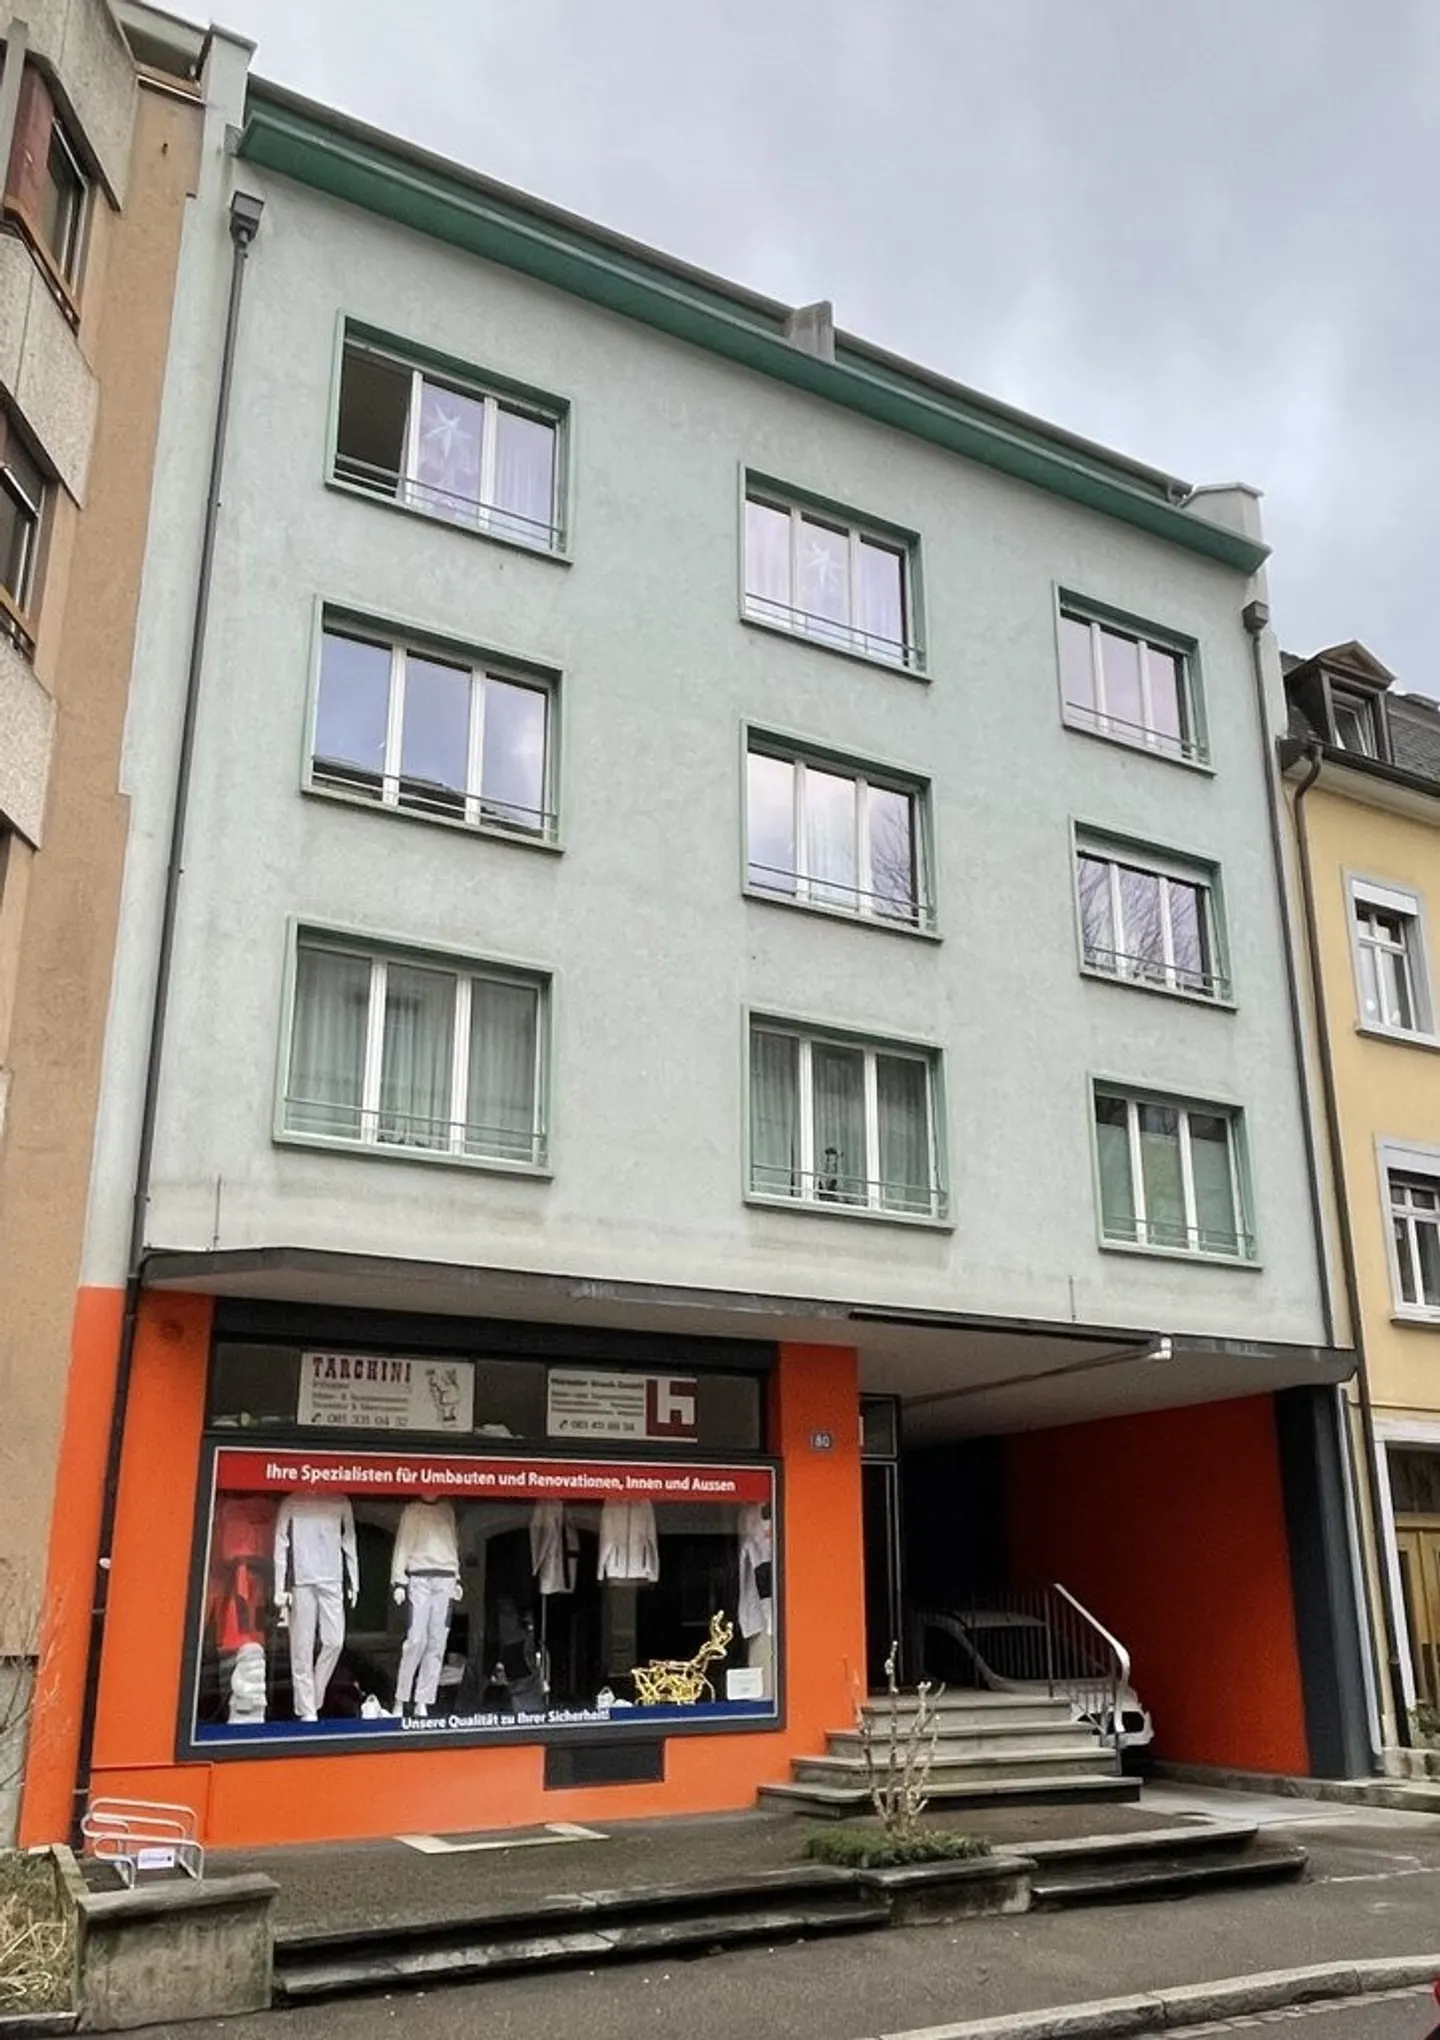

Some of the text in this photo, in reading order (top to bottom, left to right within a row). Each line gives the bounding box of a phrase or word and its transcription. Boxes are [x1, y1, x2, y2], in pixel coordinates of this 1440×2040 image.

[266, 1463, 736, 1492] Ihre Spezialisten für Umbauten und Renovationen, Innen und Aussen
[402, 1716, 447, 1730] Unsere
[448, 1712, 499, 1729] Qualität
[500, 1714, 515, 1725] zu
[517, 1711, 547, 1725] Ihrer
